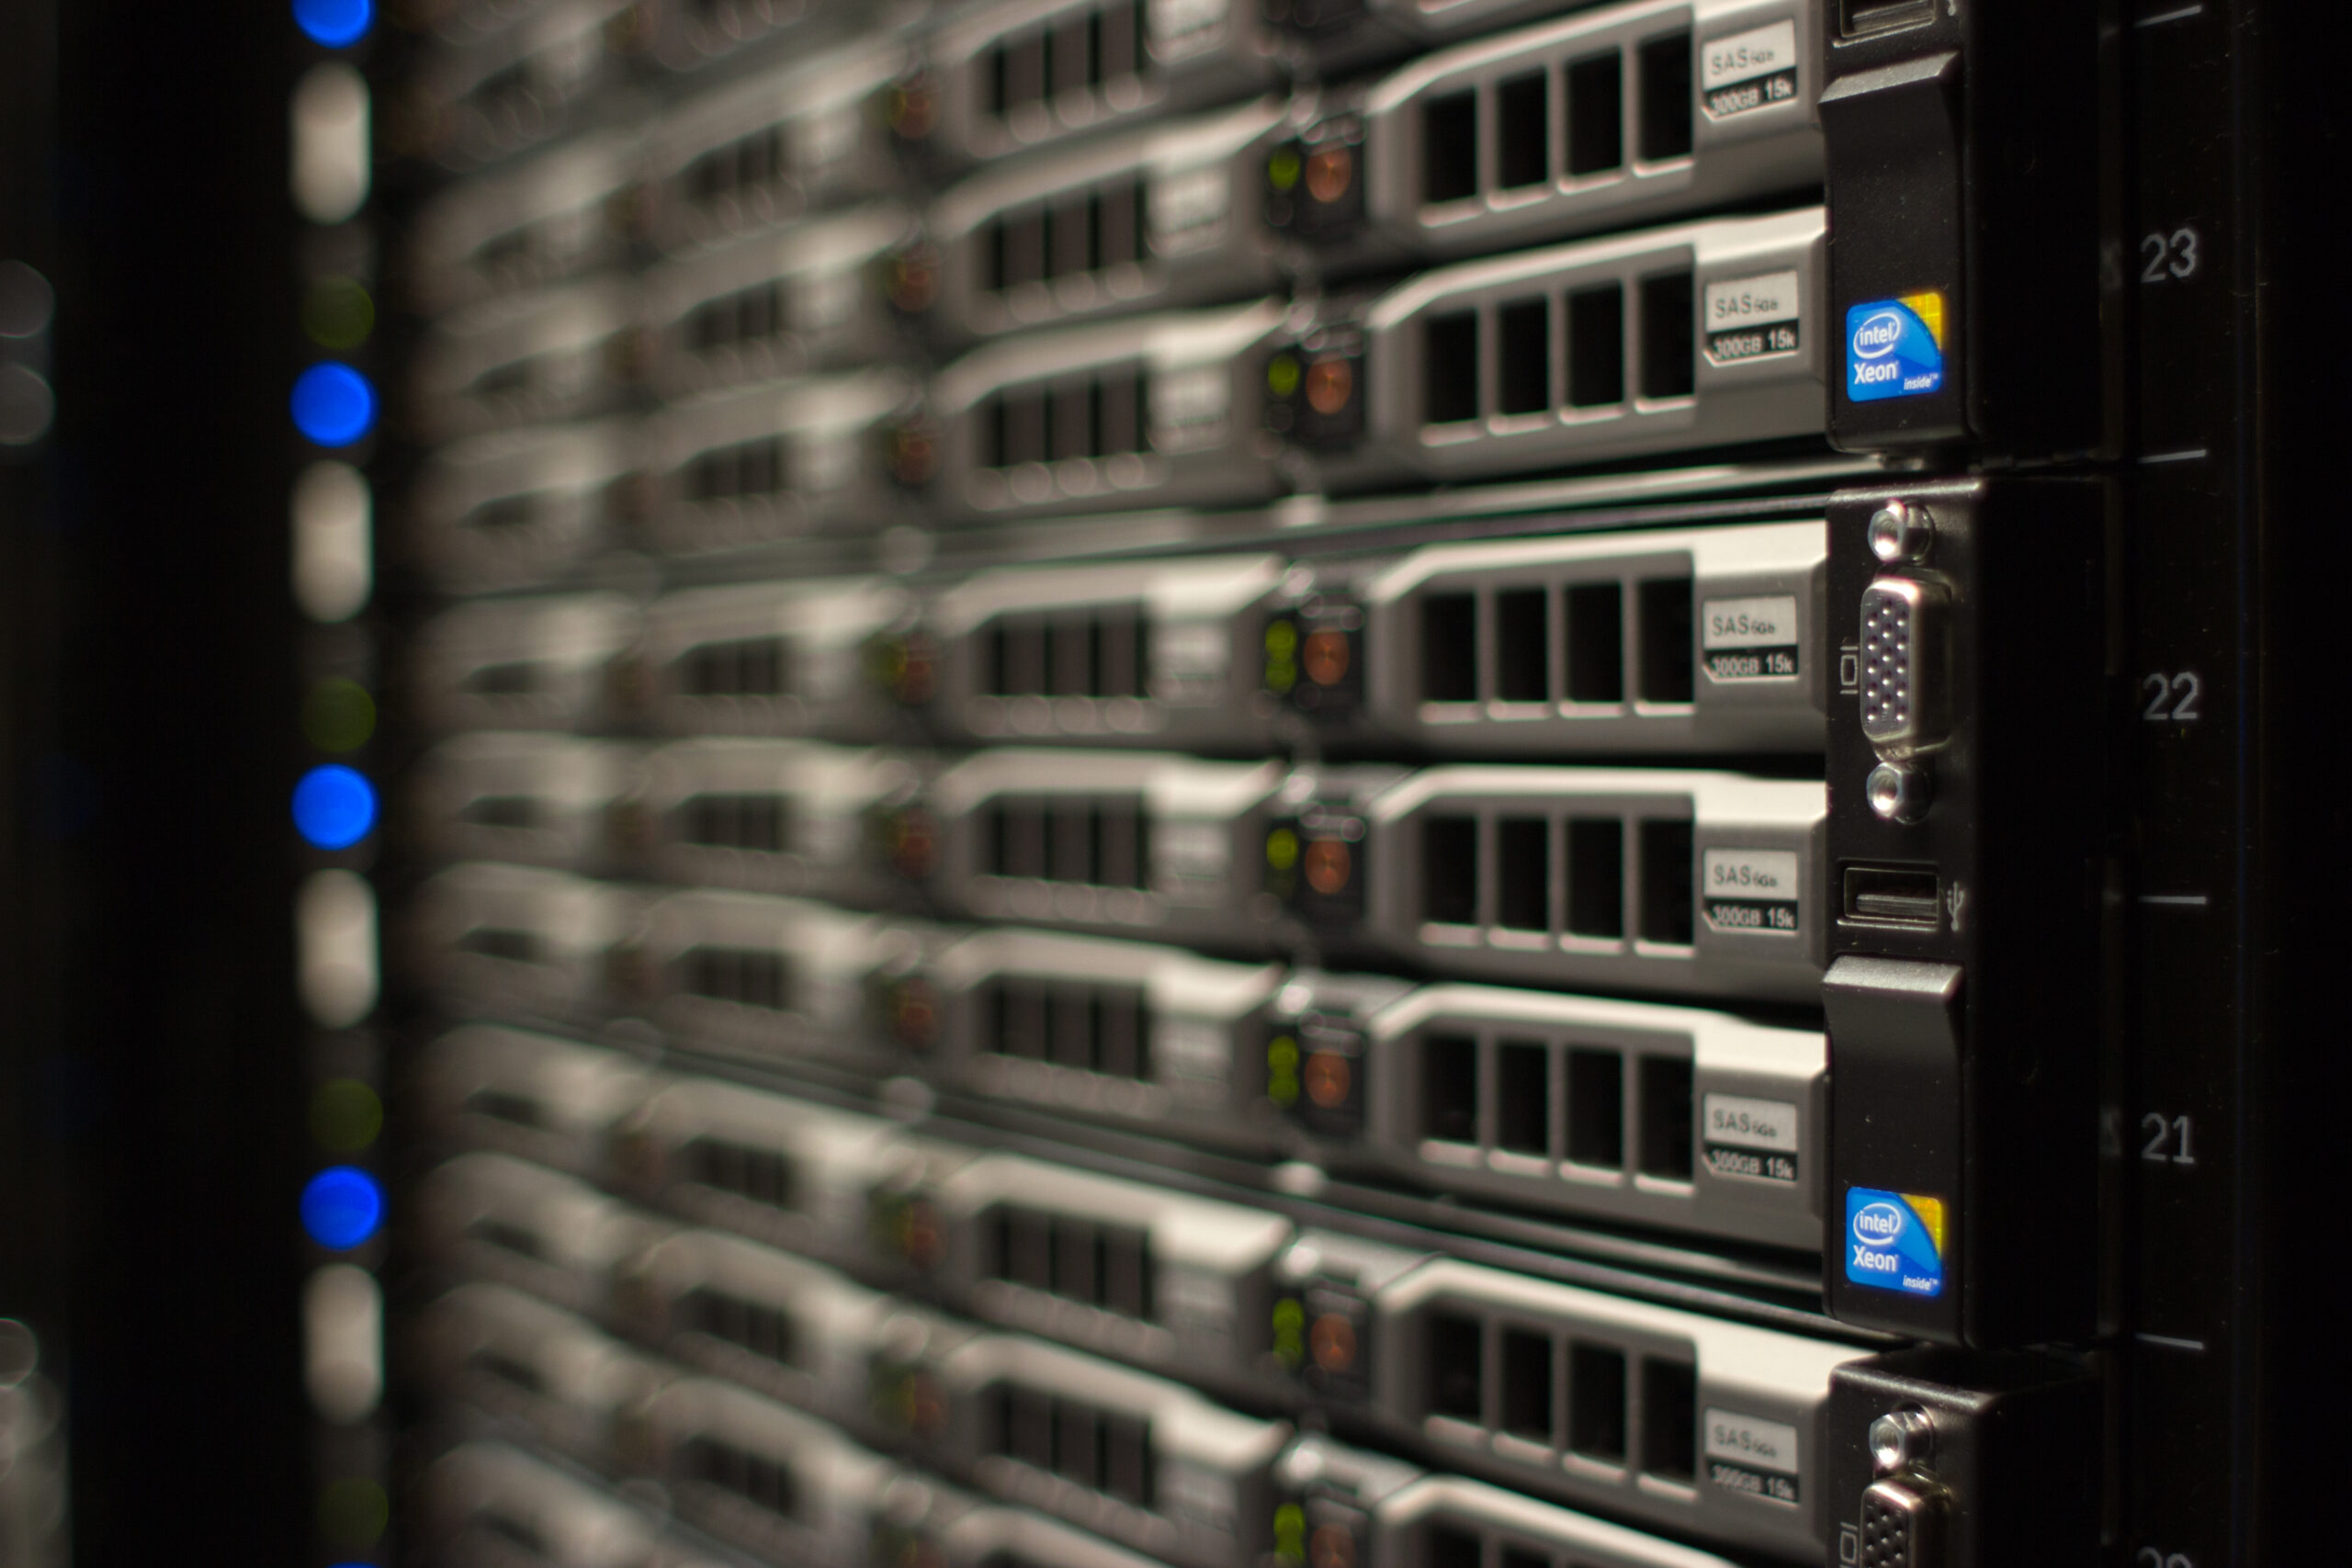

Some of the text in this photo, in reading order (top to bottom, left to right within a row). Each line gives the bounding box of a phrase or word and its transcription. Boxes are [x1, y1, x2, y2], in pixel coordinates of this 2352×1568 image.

[1711, 47, 1747, 75] SAS
[1710, 86, 1758, 116] 300GB
[2140, 228, 2197, 283] 23
[1715, 293, 1751, 319] SAS
[1713, 329, 1796, 360] 300GB 15k
[1860, 321, 1895, 346] intel
[1853, 362, 1898, 385] Xeon
[1713, 614, 1750, 637] SAS
[1712, 652, 1792, 675] 300GB 15k
[2143, 671, 2198, 720] 22
[1713, 864, 1751, 886] SAS
[1713, 906, 1794, 929] 300GB 15k
[1713, 1109, 1751, 1133] SAS
[2140, 1111, 2194, 1163] 21
[1712, 1149, 1760, 1175] 300GB
[1859, 1210, 1895, 1234] intel
[1852, 1245, 1898, 1272] Xeon
